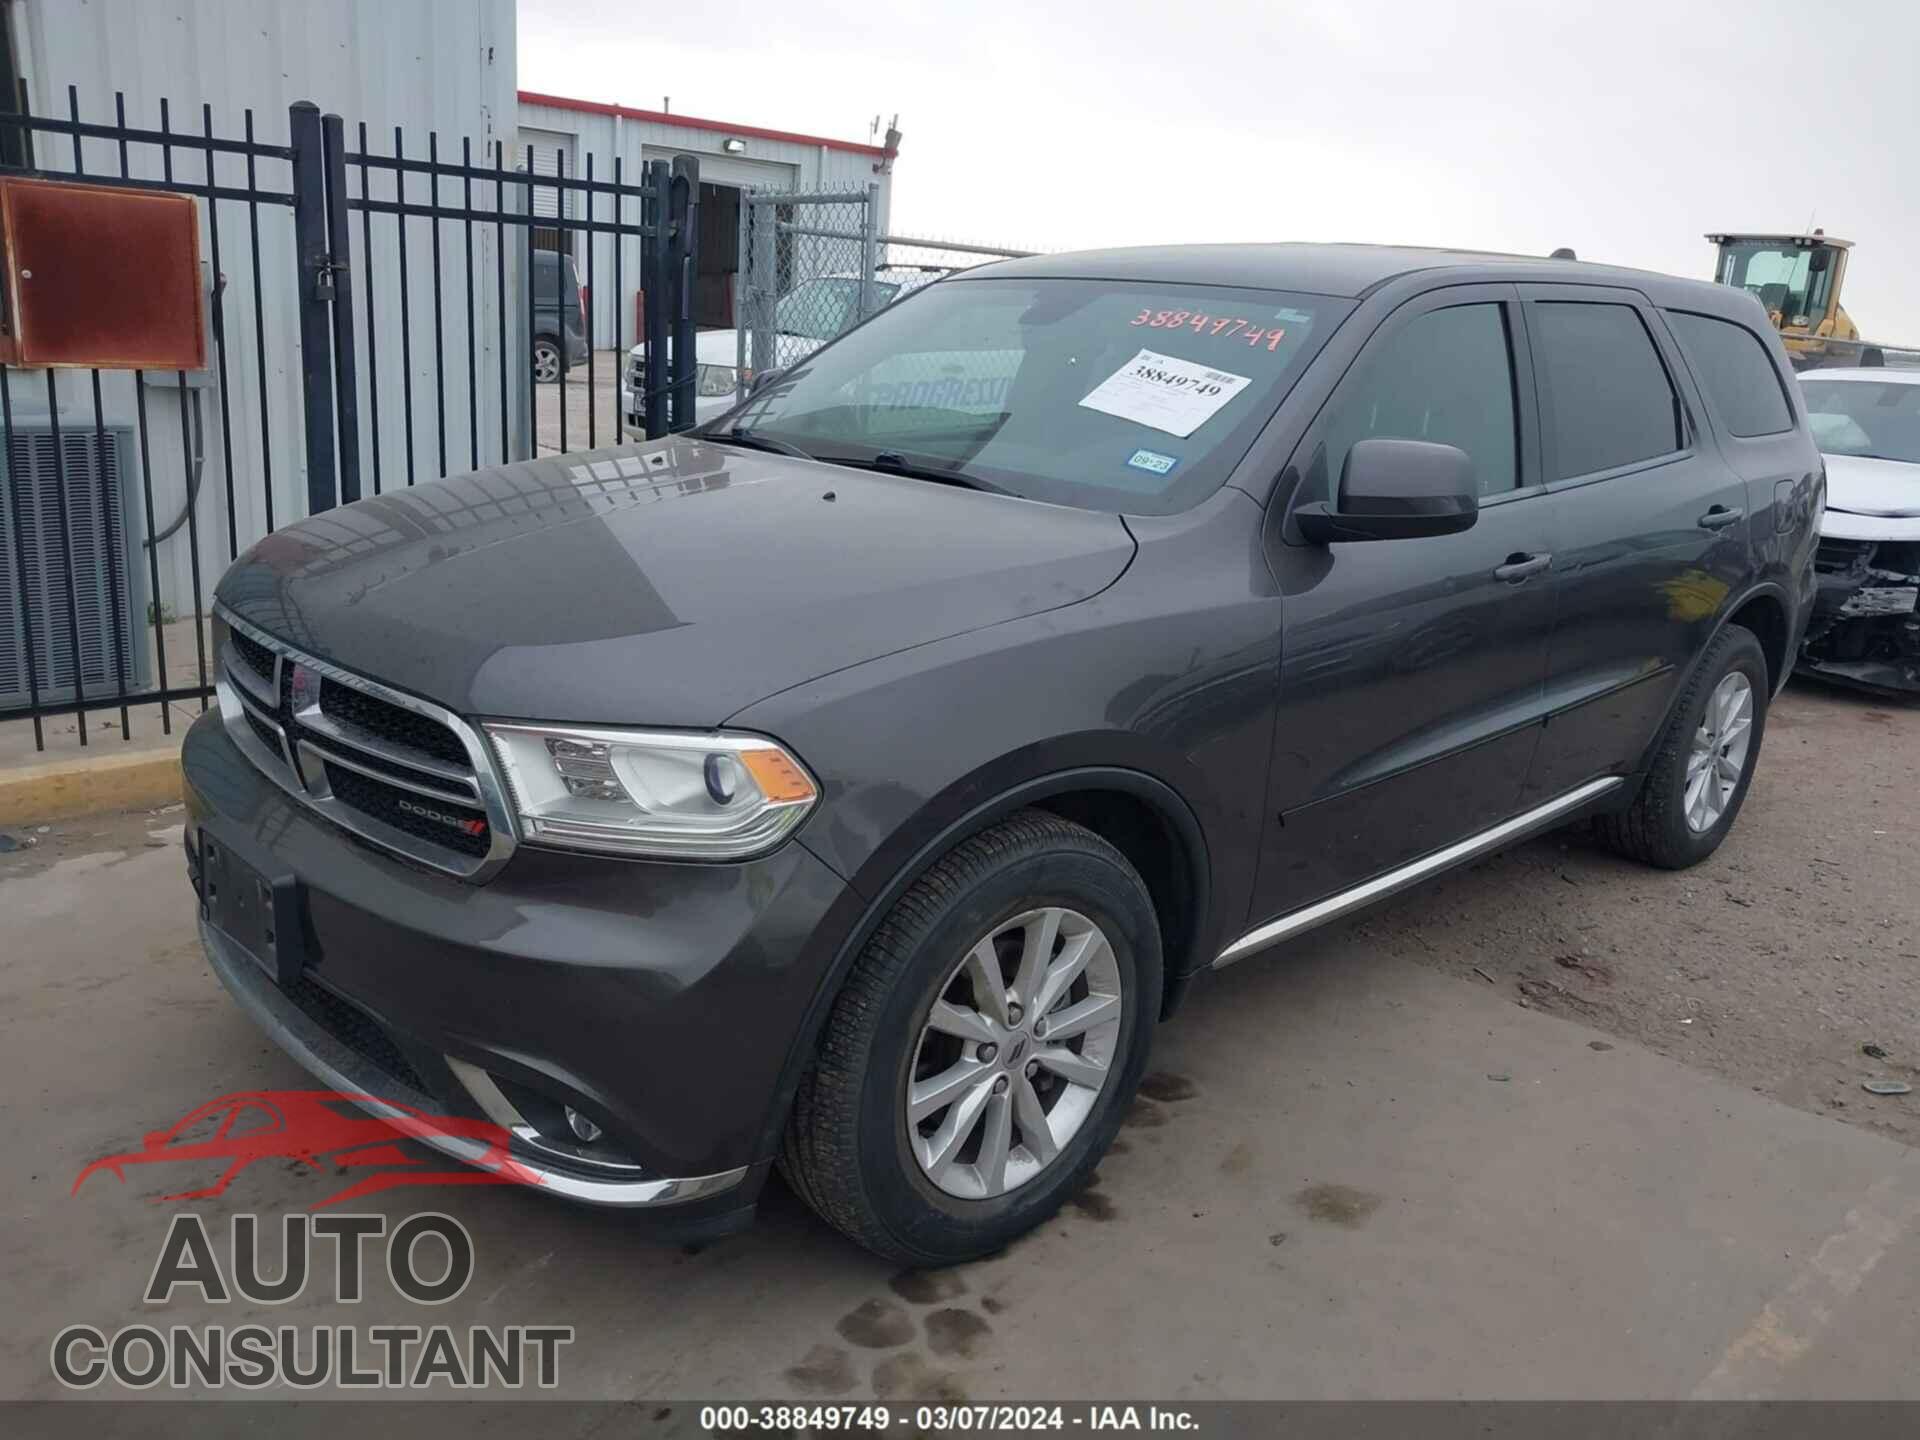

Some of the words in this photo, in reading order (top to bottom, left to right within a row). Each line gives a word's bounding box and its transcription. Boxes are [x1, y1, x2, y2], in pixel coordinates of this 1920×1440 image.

[1130, 308, 1285, 351] 38849749
[1129, 365, 1222, 397] 38849749
[399, 800, 464, 829] DODGE
